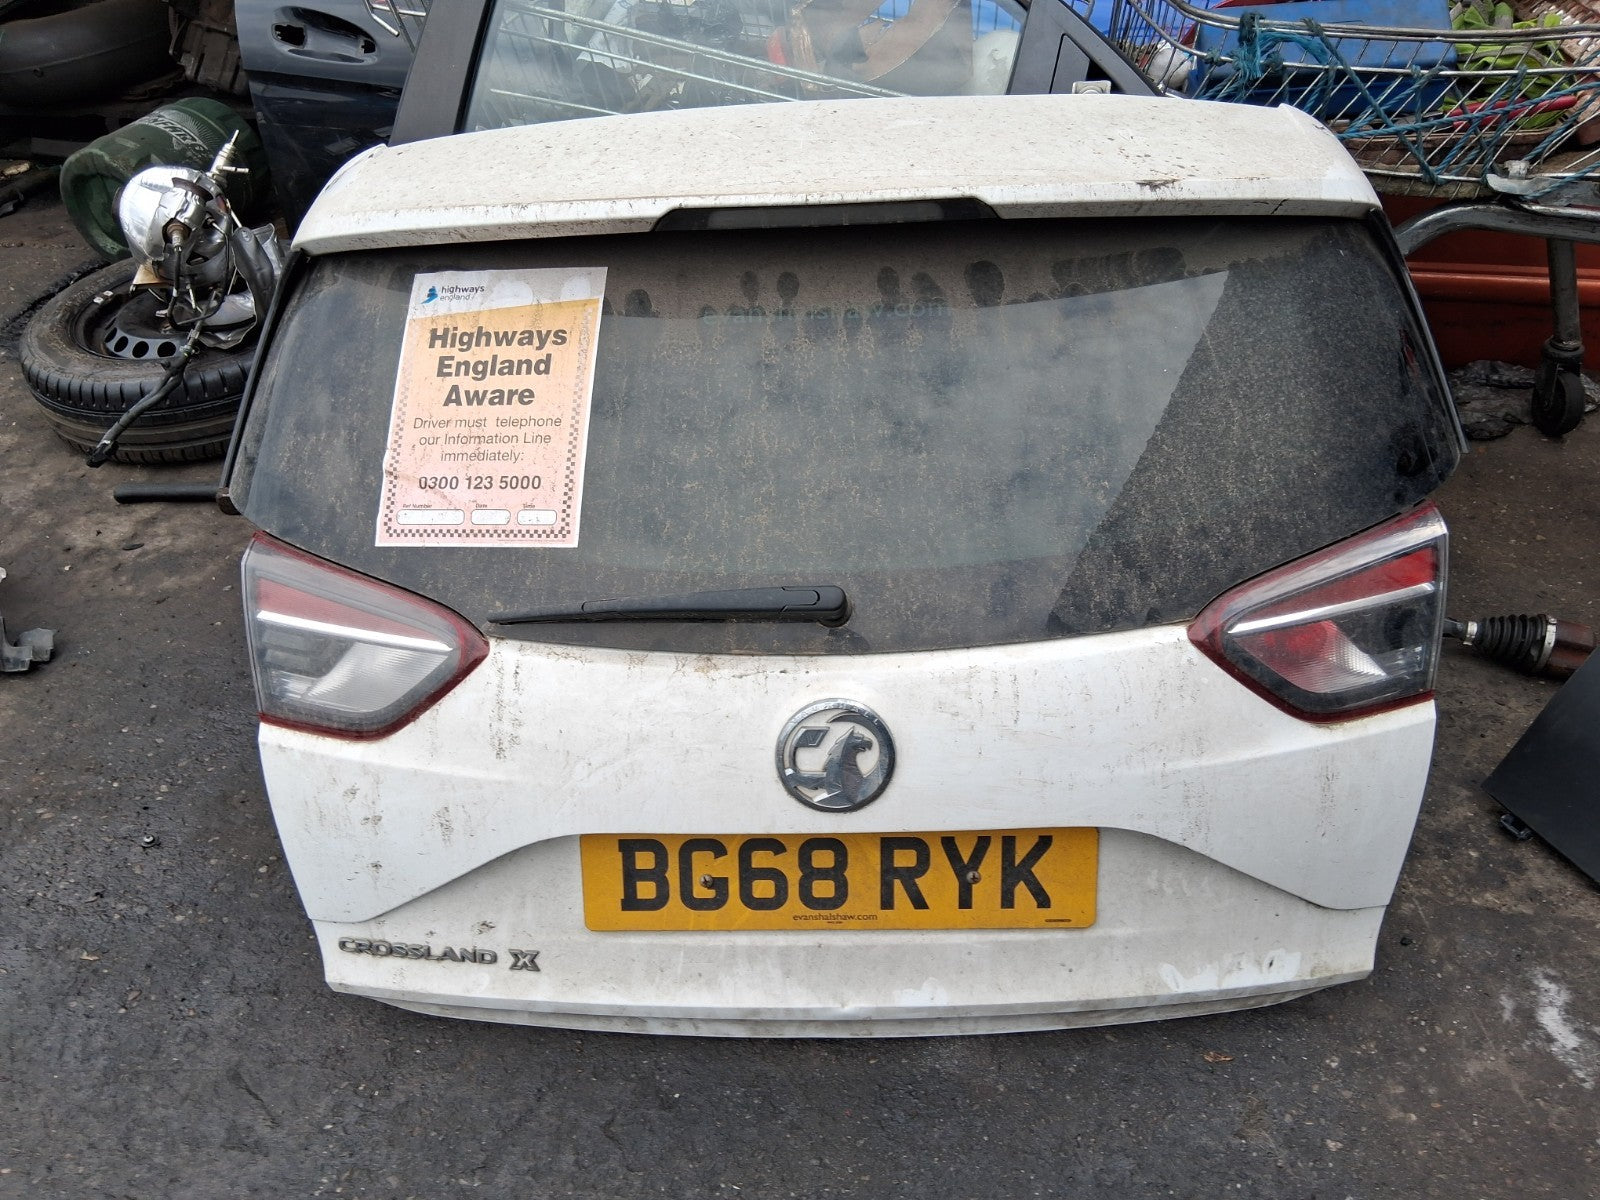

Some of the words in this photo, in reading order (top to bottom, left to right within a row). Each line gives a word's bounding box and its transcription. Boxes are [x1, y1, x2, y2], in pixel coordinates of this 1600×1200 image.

[441, 284, 485, 294] highways
[428, 325, 568, 353] Highways
[436, 353, 552, 381] England
[443, 384, 536, 407] Aware
[413, 417, 450, 429] Driver
[454, 417, 487, 428] must
[496, 416, 562, 430] telephone
[419, 435, 440, 446] our
[444, 433, 519, 445] Information
[524, 432, 552, 444] Line
[440, 450, 524, 462] immediately:
[418, 476, 459, 490] 0300
[466, 475, 494, 490] 123
[499, 475, 542, 490] 5000
[618, 837, 849, 912] BG68
[879, 835, 1054, 910] RYK
[792, 913, 878, 921] evanshalshaw.com
[338, 936, 498, 964] CROSSLAND
[508, 948, 541, 972] X
